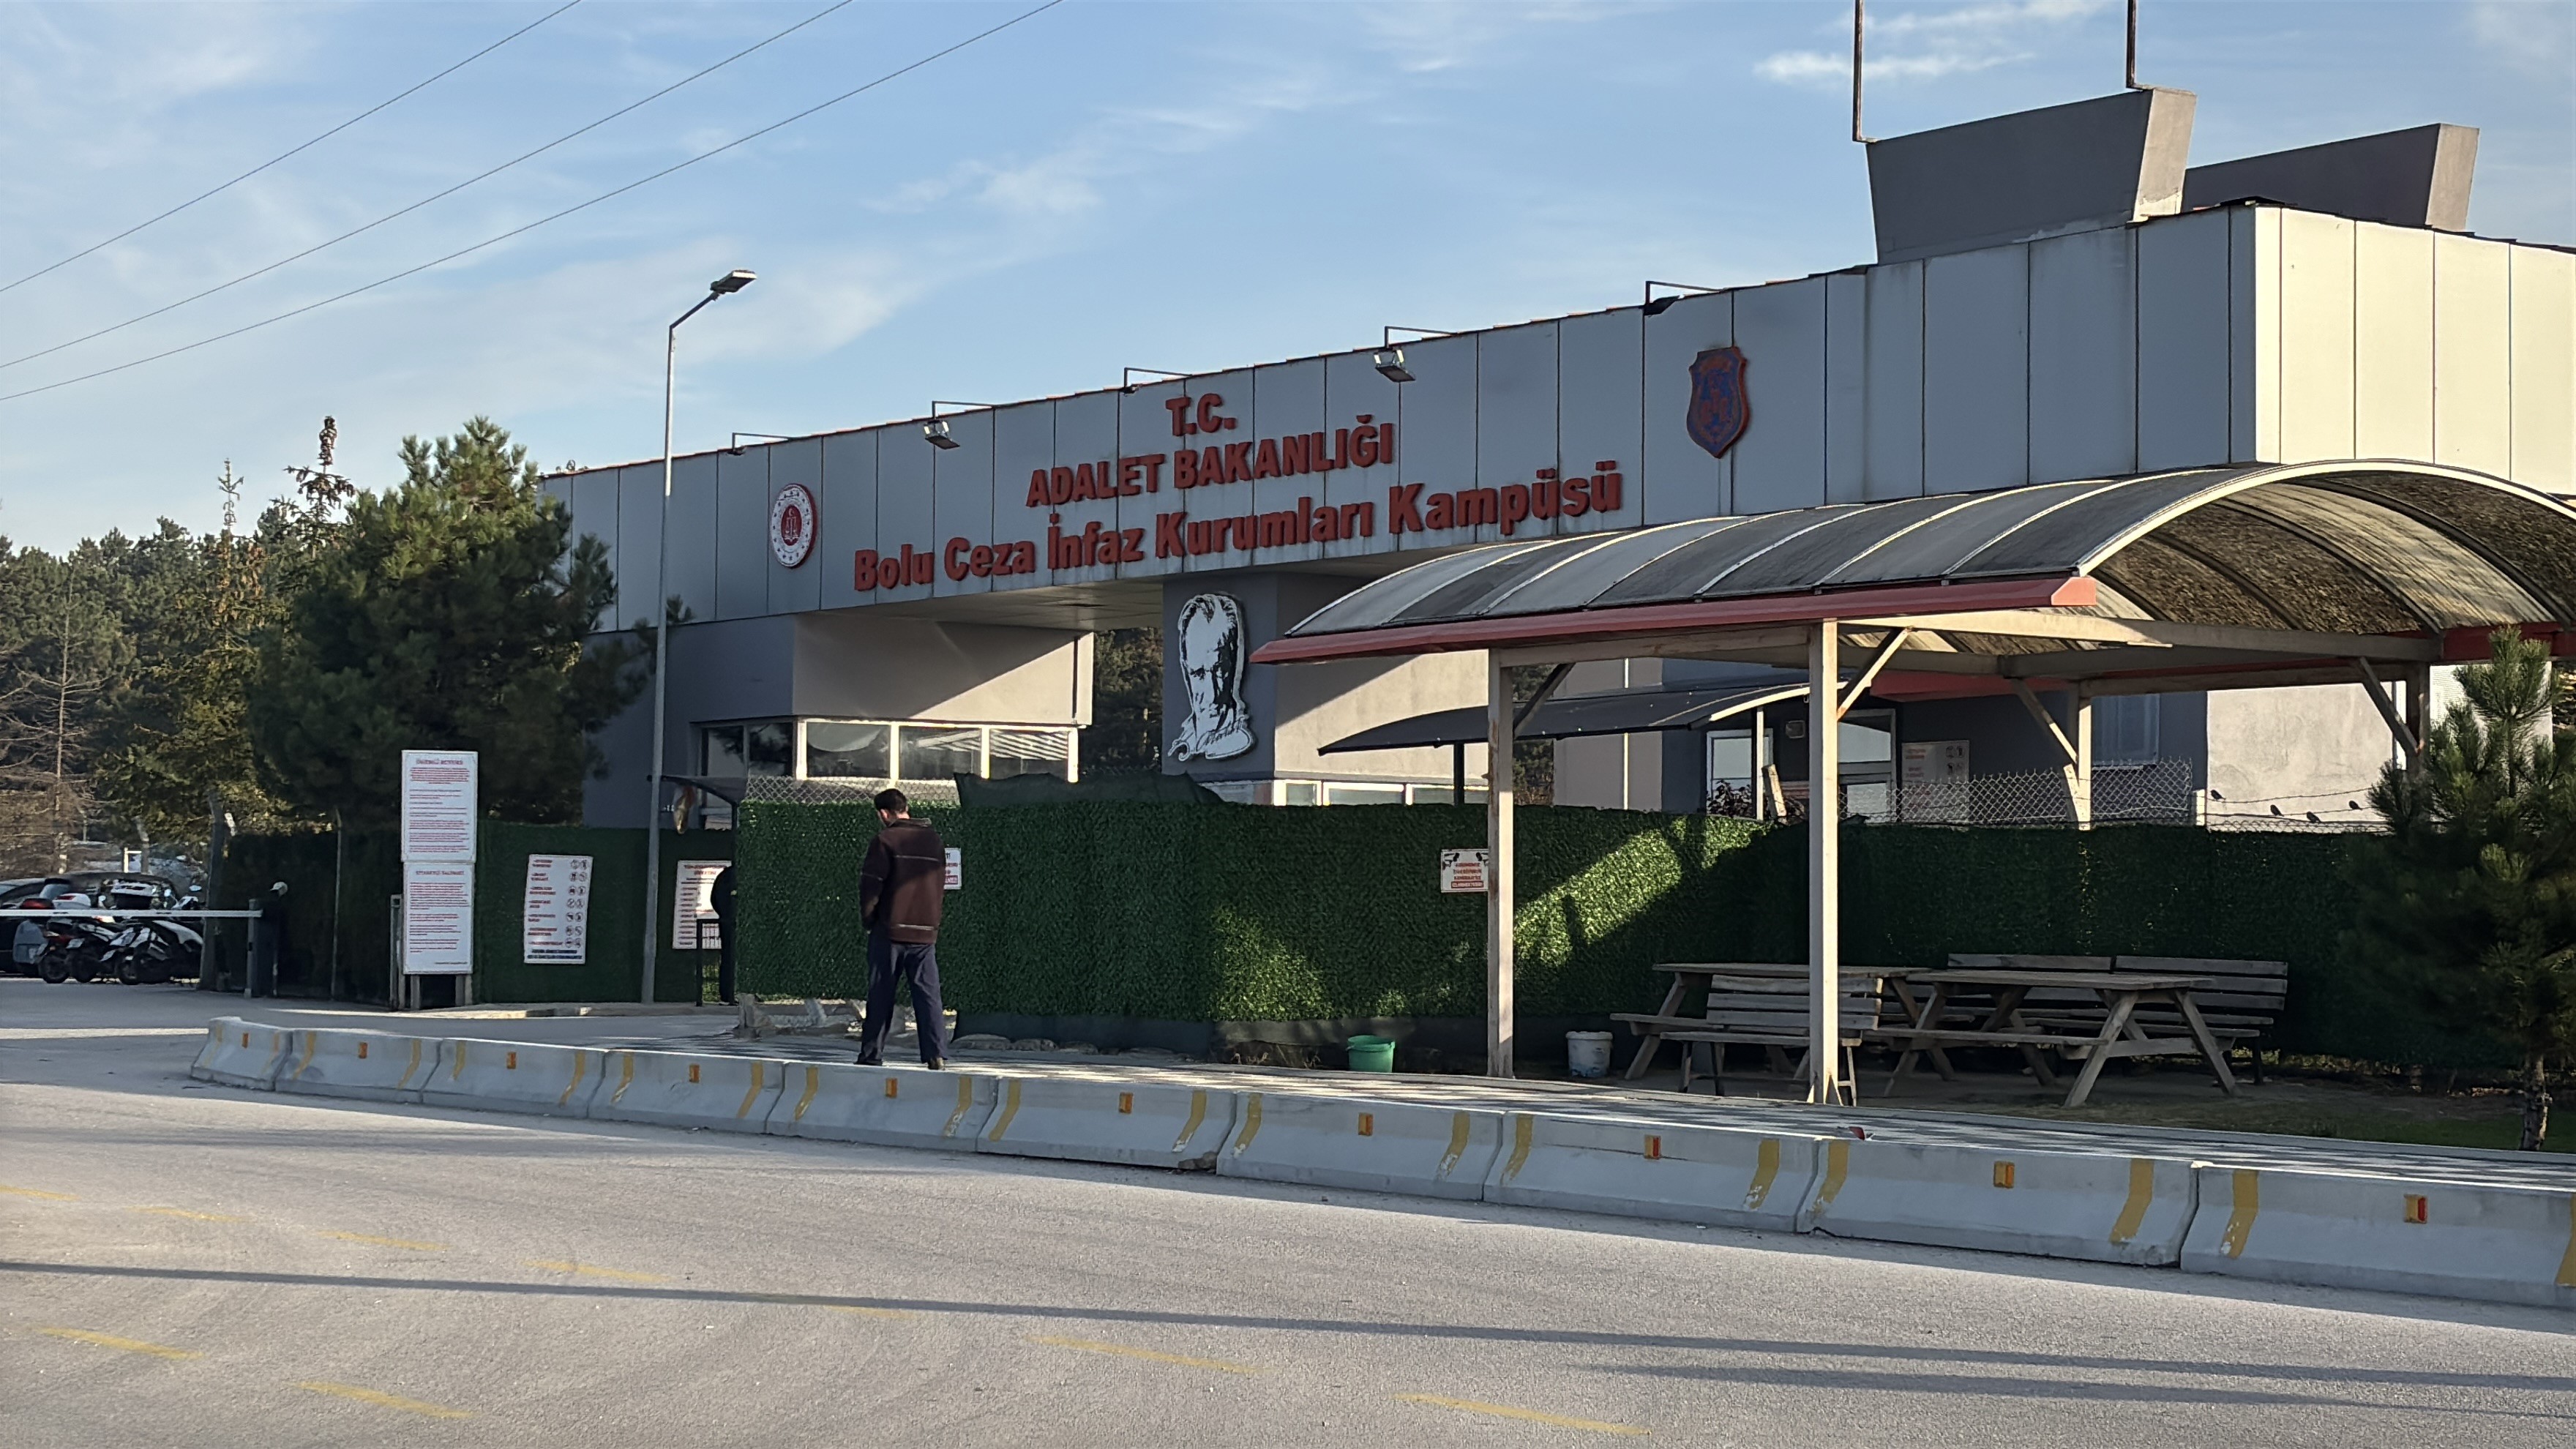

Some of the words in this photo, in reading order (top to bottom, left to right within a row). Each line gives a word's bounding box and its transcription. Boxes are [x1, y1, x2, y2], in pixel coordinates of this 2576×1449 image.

[1026, 453, 1165, 507] ADALET
[1173, 414, 1393, 489] BAKANLIĞI
[1165, 392, 1237, 437] T.C.
[854, 543, 935, 591] Bolu
[944, 536, 1036, 582] Ceza
[1047, 513, 1145, 570] İnfaz
[1156, 488, 1373, 558] Kurumları
[1388, 460, 1623, 536] Kampüsü
